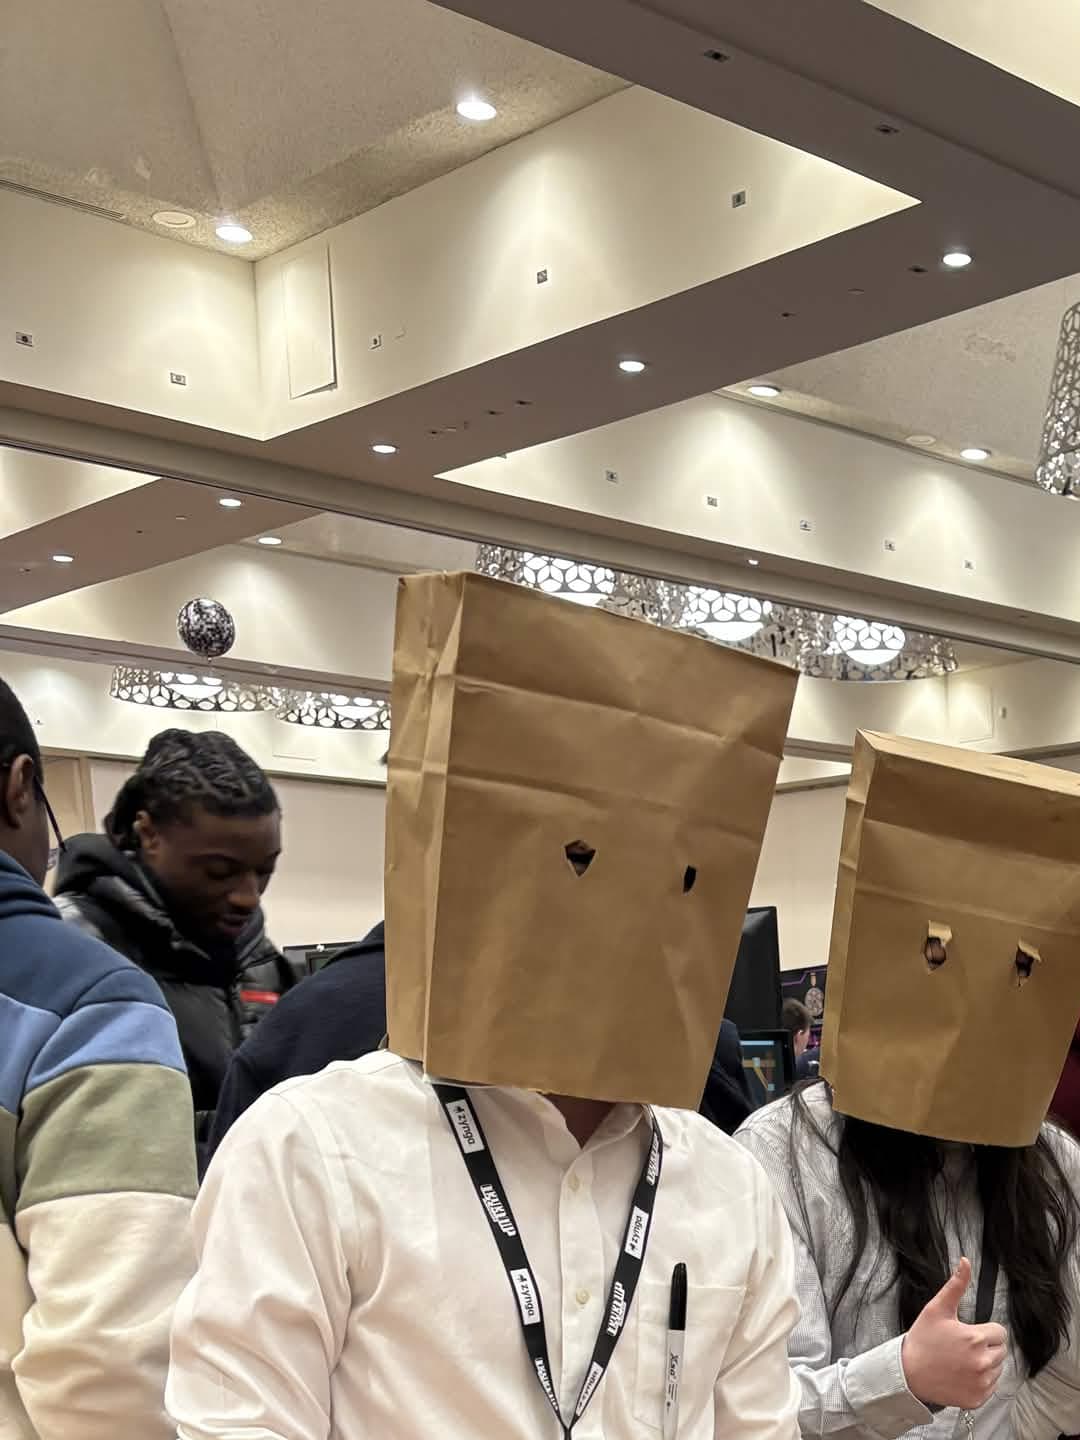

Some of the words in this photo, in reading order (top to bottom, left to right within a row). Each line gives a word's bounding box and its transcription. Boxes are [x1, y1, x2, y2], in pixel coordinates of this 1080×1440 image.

[458, 1112, 476, 1145] zynga
[632, 1214, 643, 1244] zynga
[520, 1283, 535, 1317] zynga
